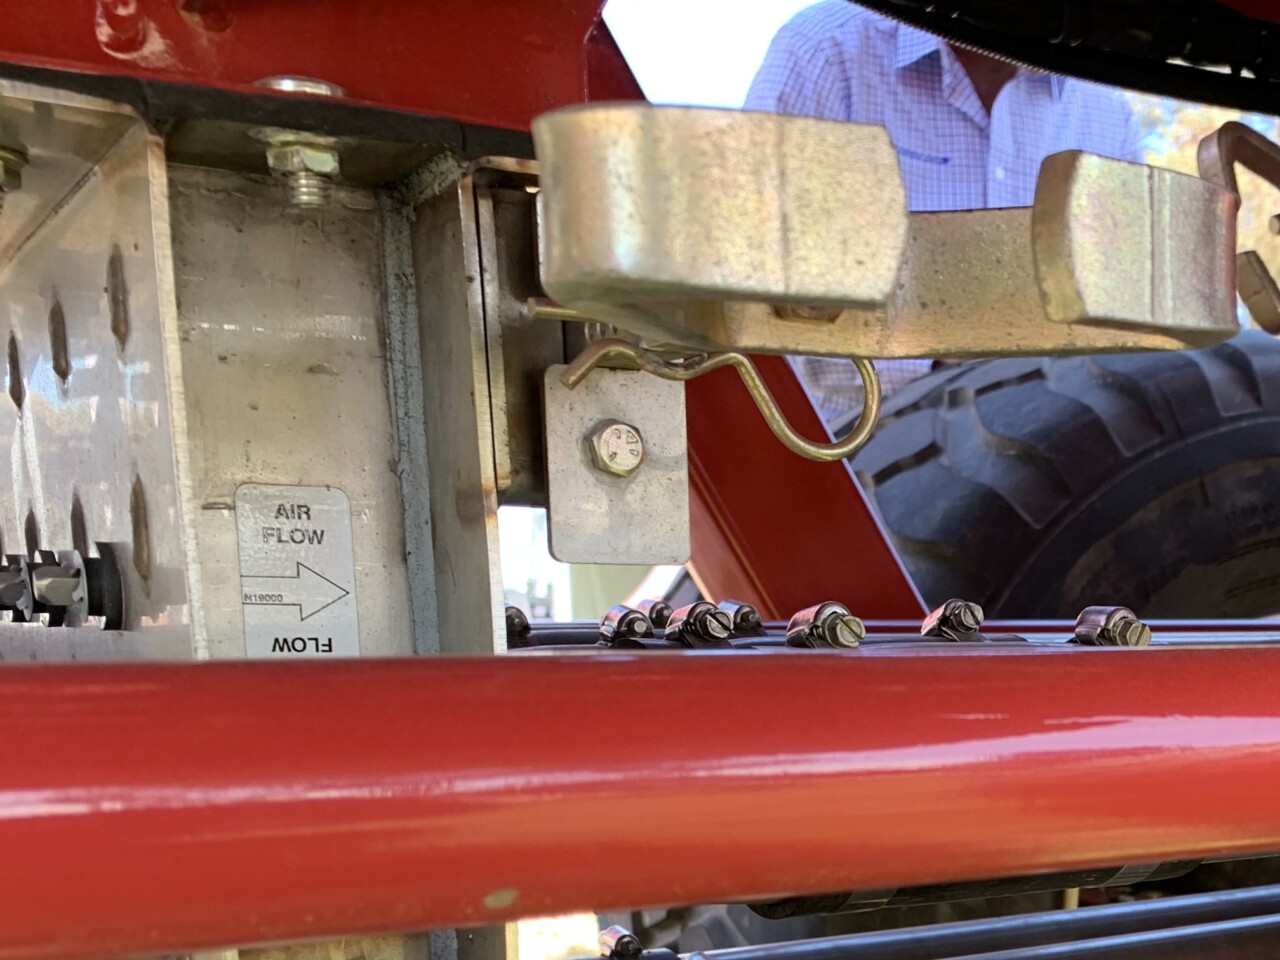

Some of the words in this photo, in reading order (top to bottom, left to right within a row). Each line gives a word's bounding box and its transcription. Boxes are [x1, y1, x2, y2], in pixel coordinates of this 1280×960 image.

[274, 503, 312, 521] AIR
[262, 527, 325, 545] FLOW
[243, 593, 284, 603] N19000
[271, 637, 333, 653] FLOW
